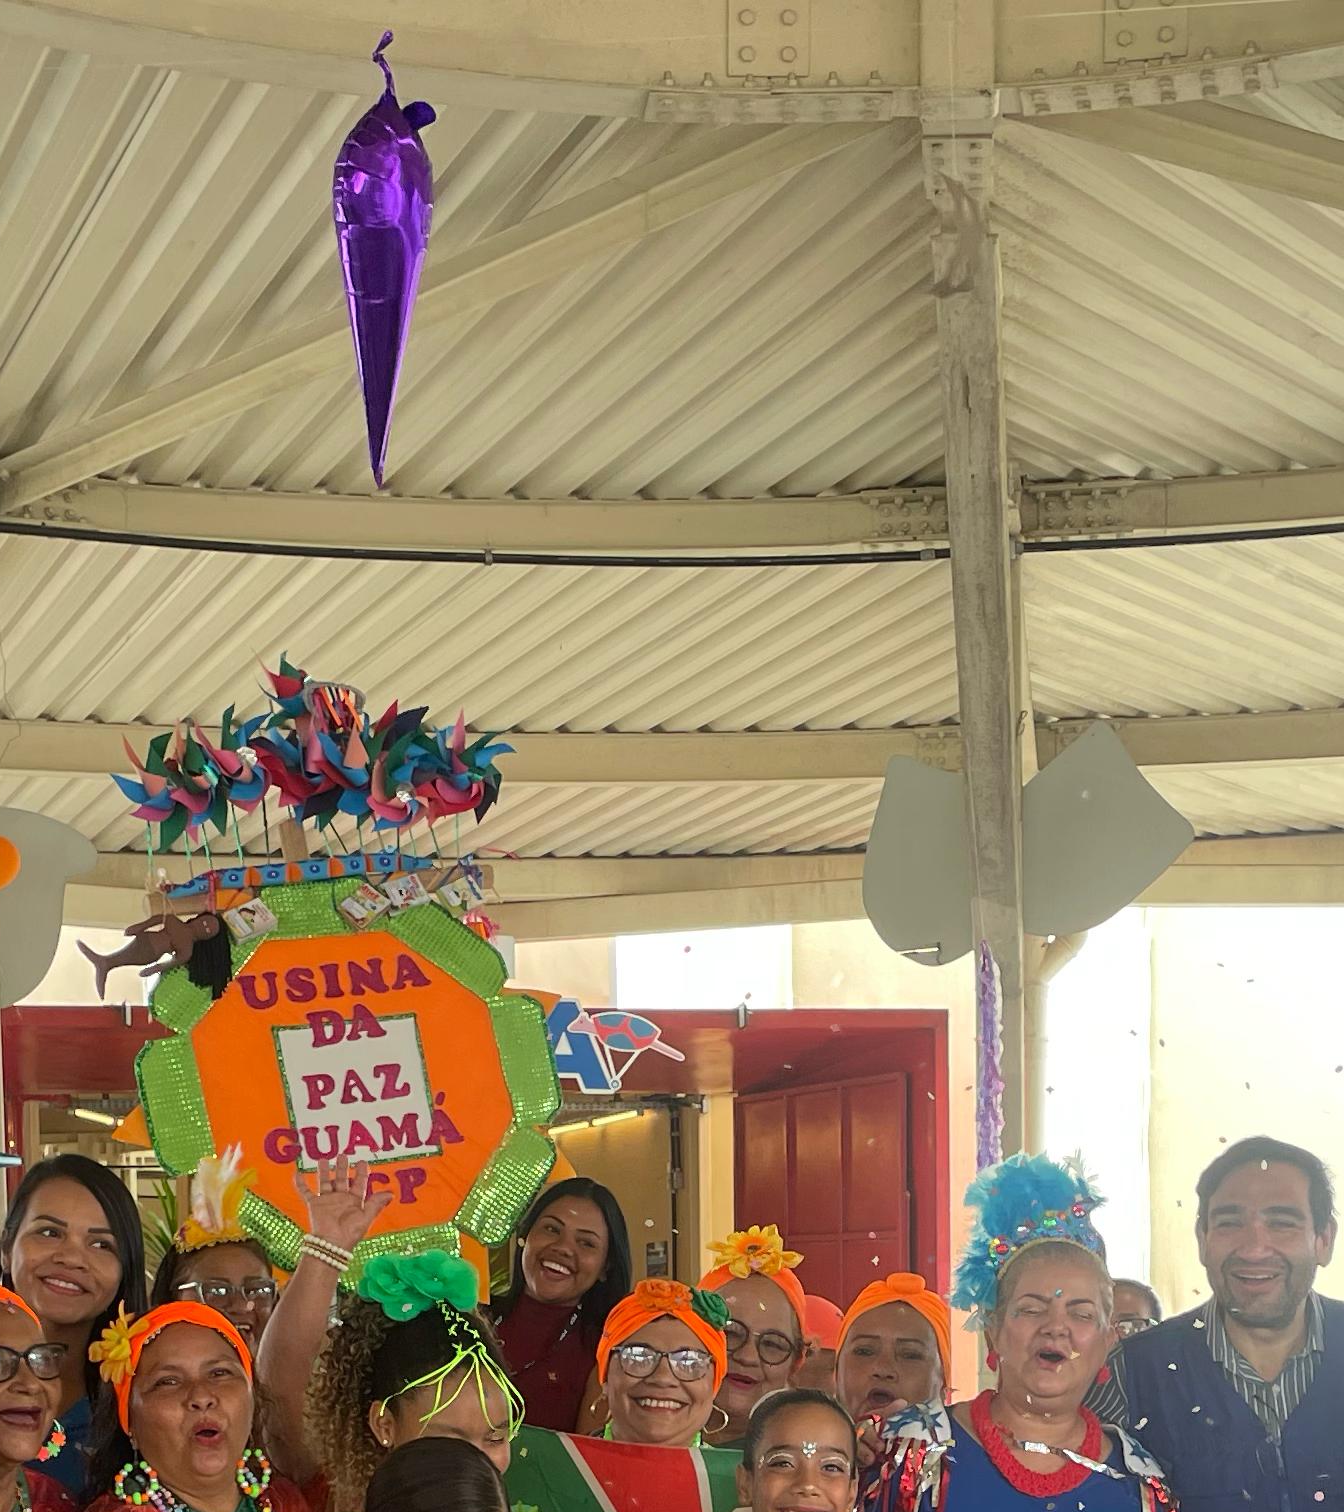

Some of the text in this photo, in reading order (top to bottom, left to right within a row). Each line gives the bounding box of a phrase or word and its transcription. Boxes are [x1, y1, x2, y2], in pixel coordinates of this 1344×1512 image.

[236, 953, 432, 1010] USINA
[306, 1003, 387, 1048] DA
[302, 1063, 411, 1110] PAZ
[263, 1091, 465, 1164] GUAMÁ
